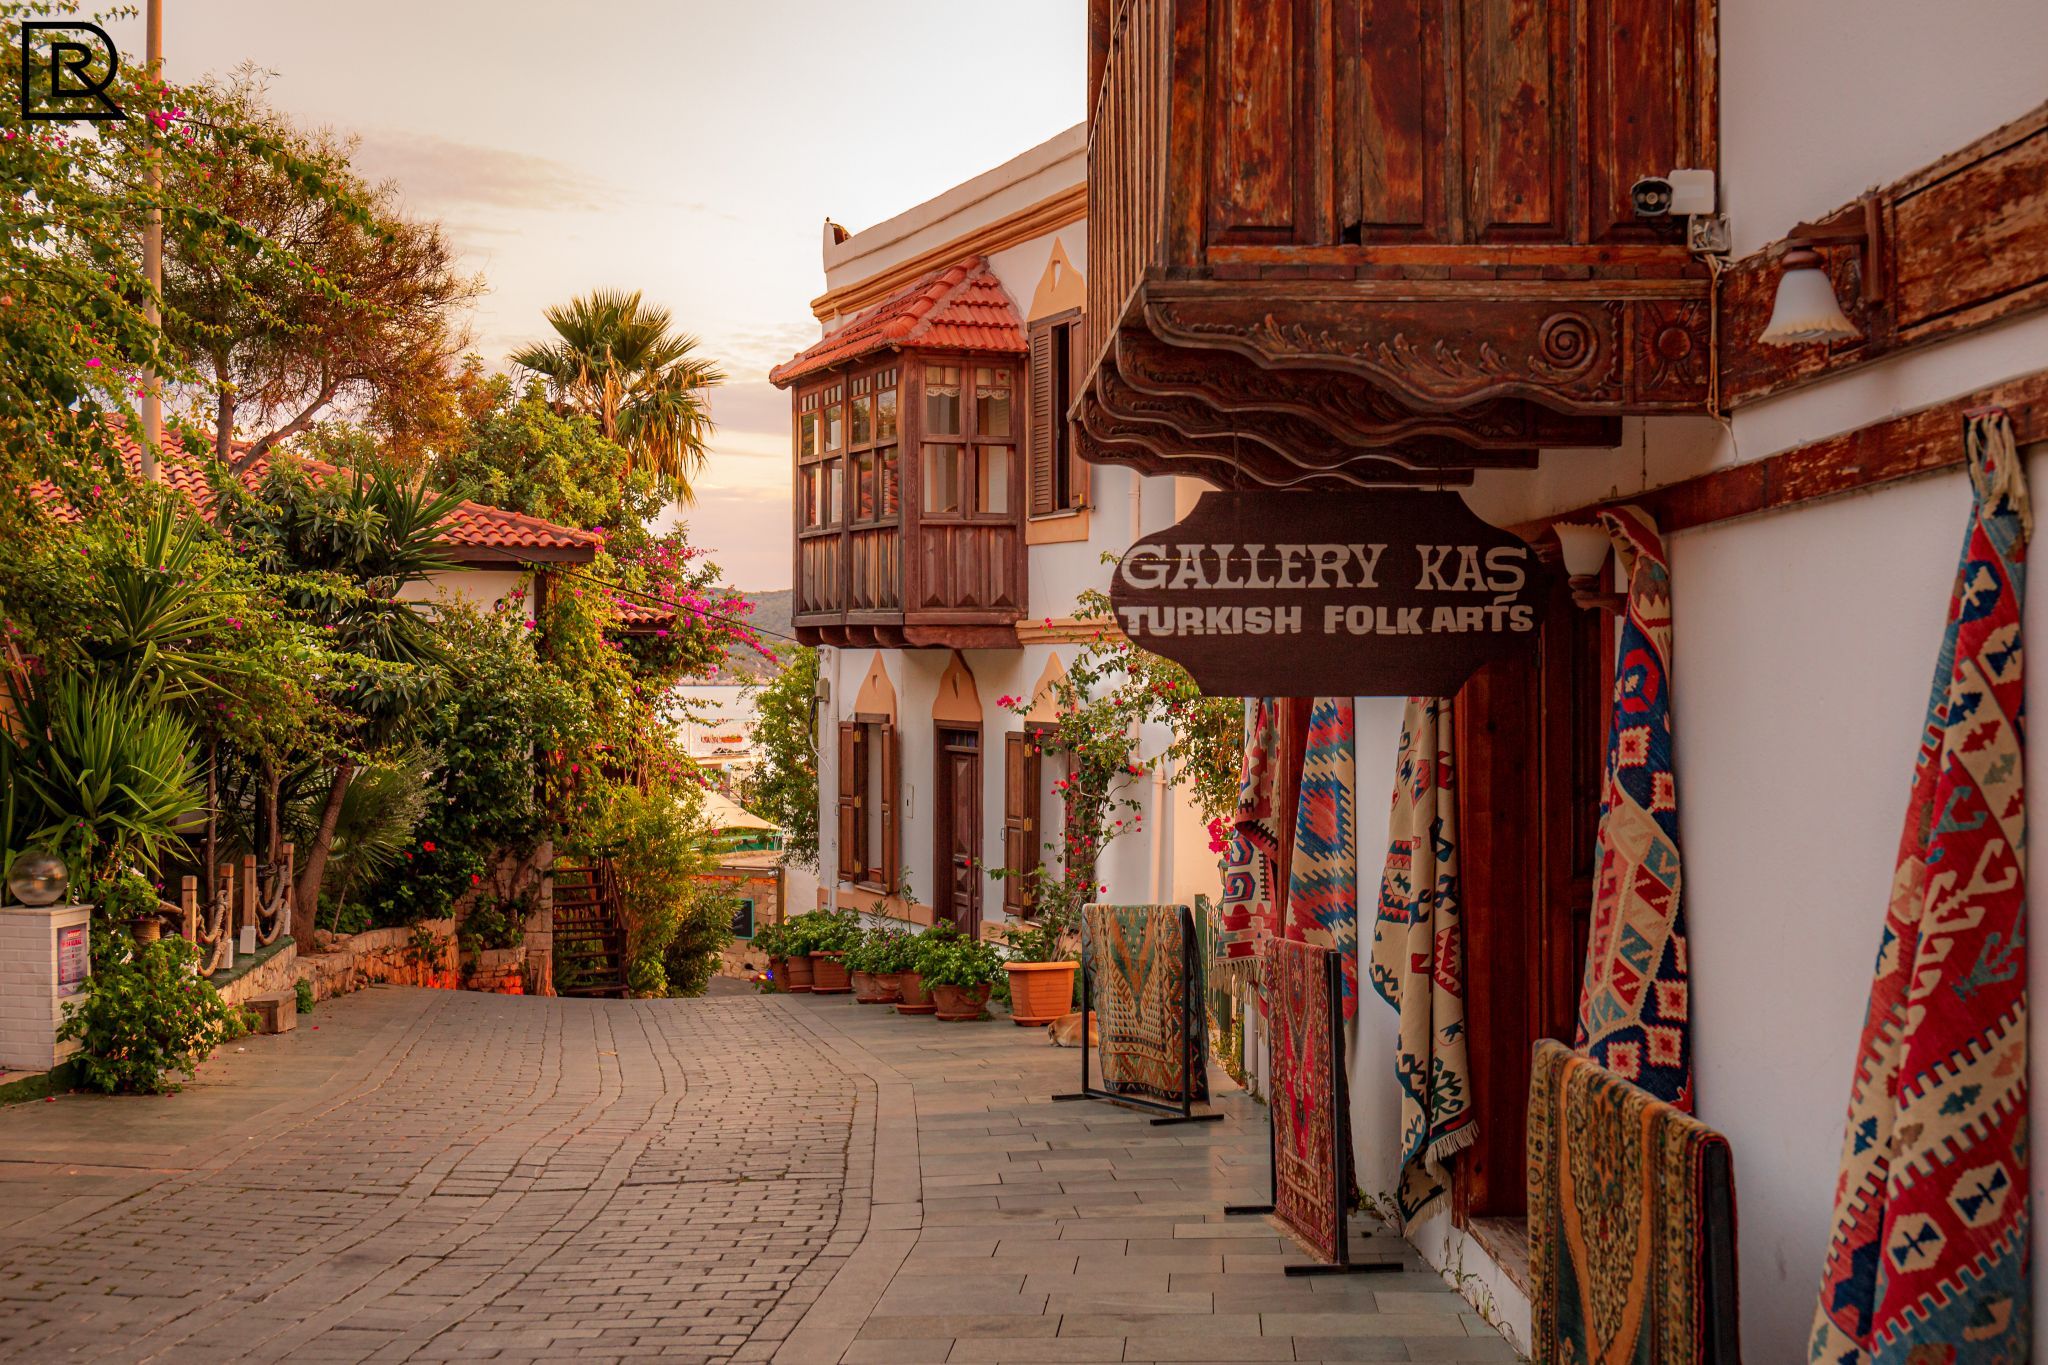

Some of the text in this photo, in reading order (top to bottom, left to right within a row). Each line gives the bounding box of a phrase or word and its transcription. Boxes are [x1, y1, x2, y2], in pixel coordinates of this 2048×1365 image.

[1121, 543, 1388, 589] GALLERY
[1118, 605, 1534, 636] TURKISH FOLK ARTS
